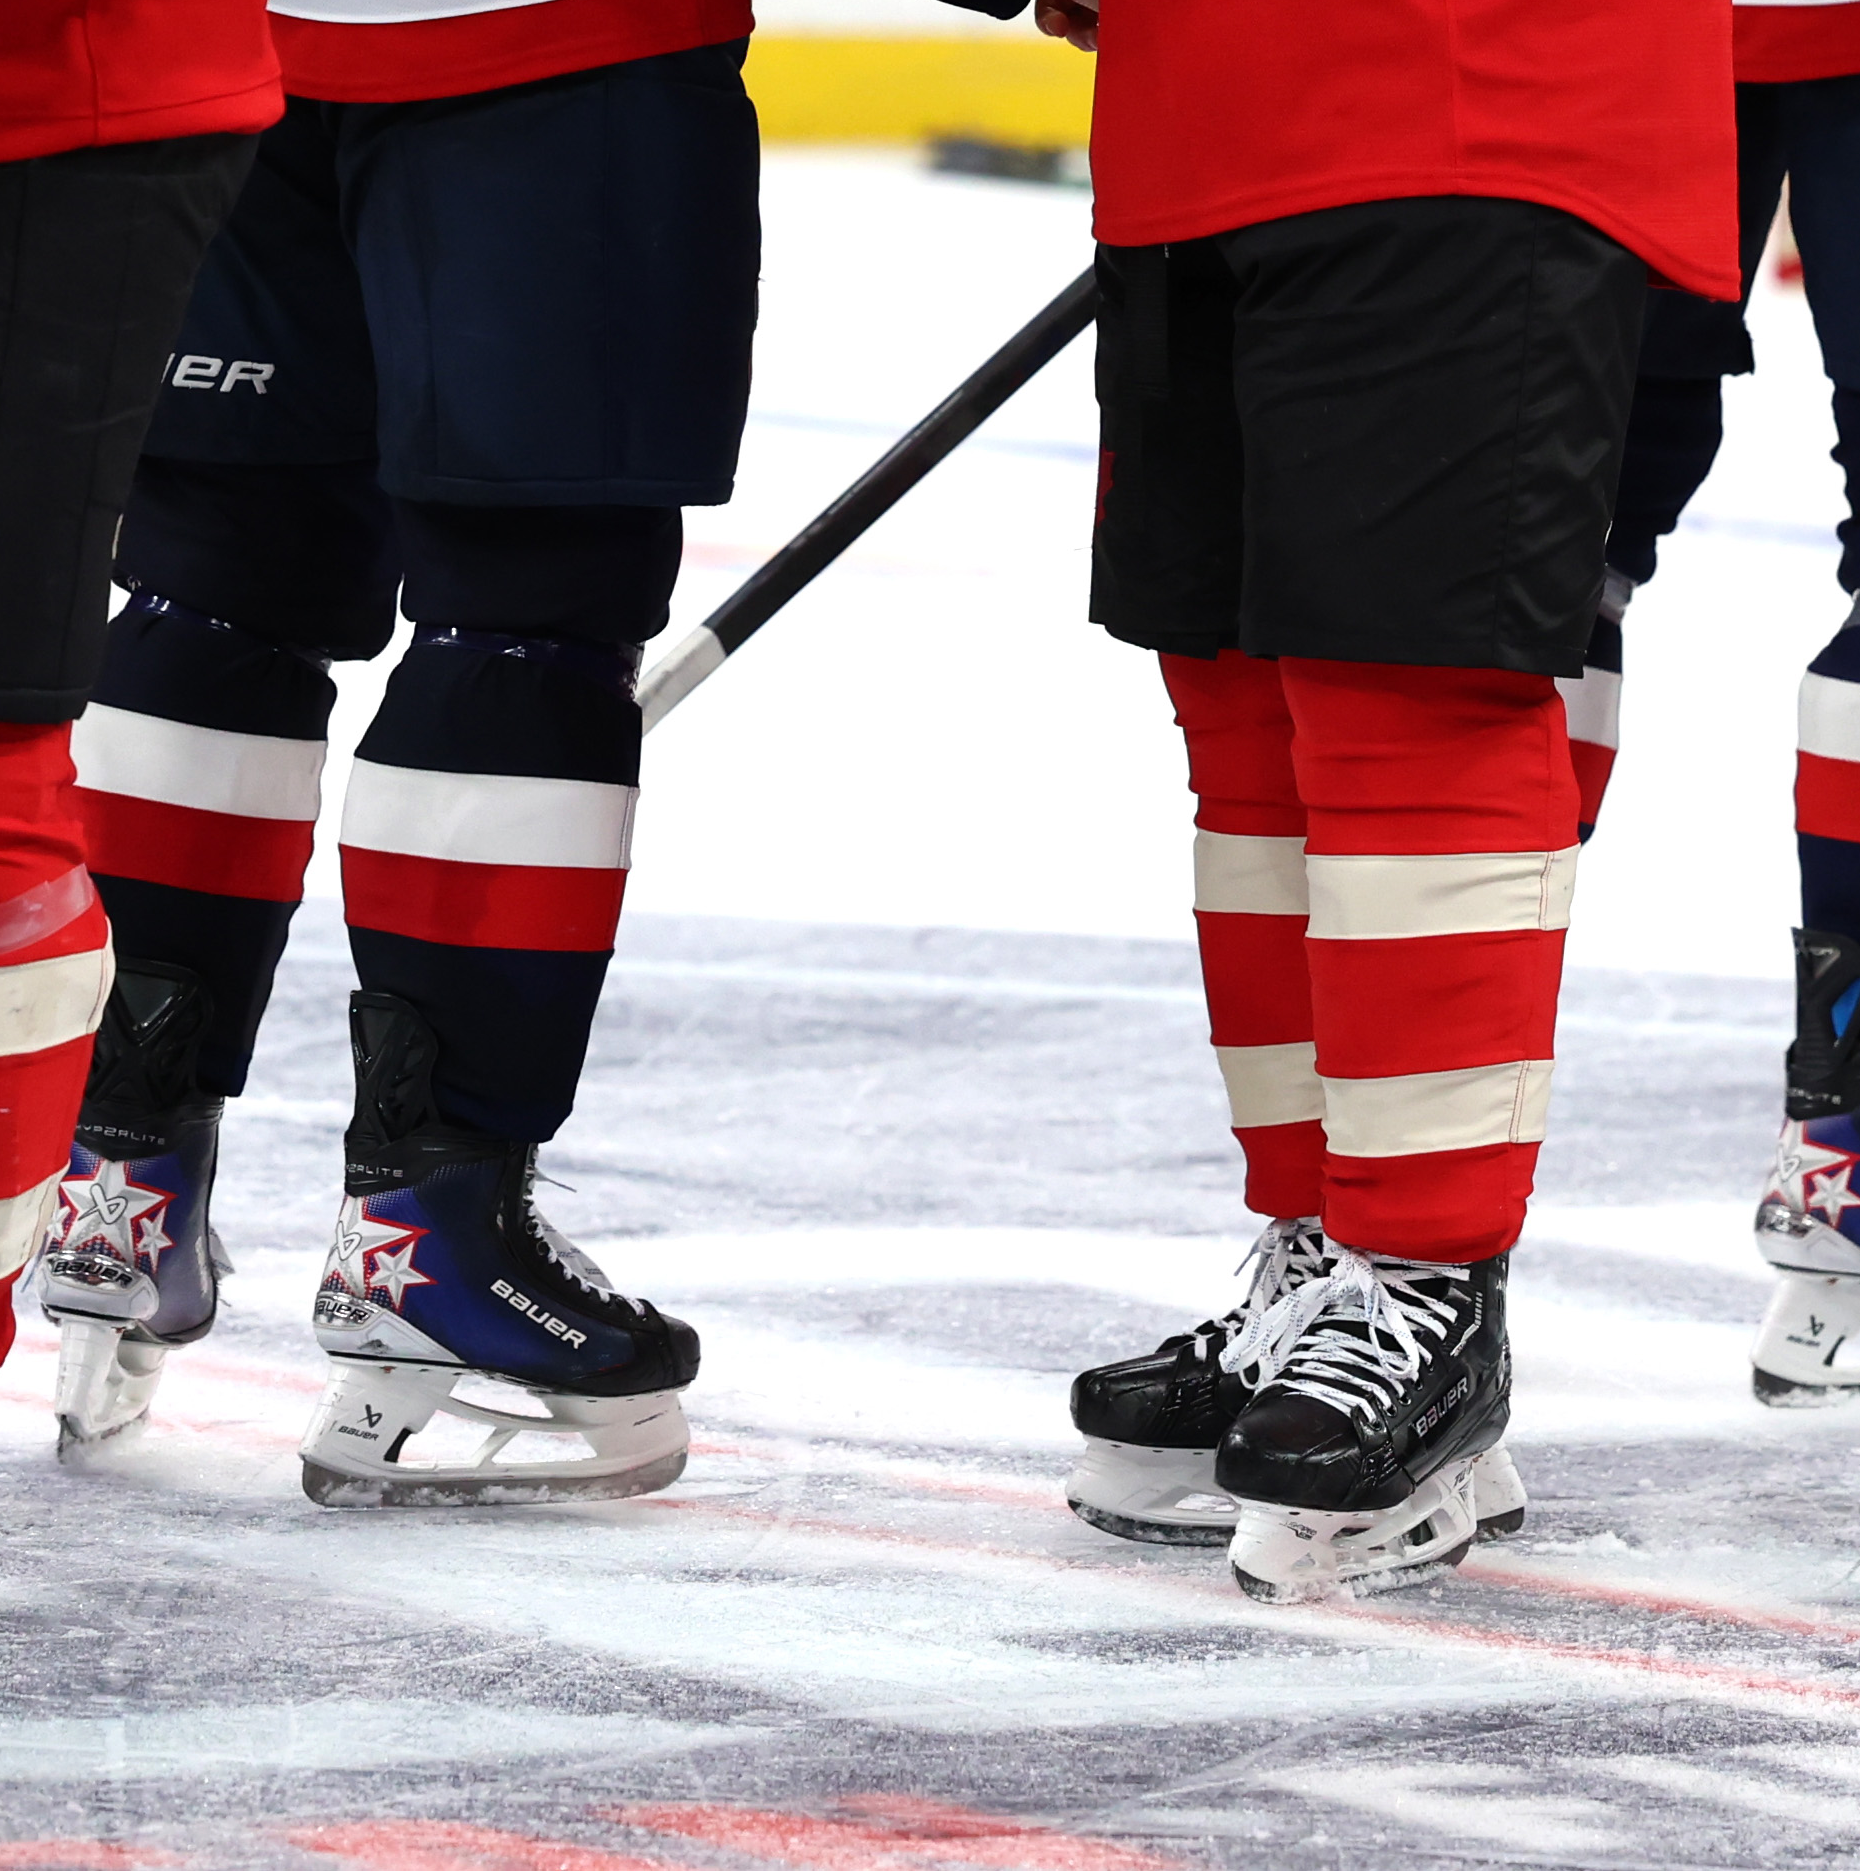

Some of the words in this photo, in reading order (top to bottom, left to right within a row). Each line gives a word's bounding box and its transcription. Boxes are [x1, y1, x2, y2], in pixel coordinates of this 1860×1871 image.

[52, 1260, 134, 1288] BAUER
[315, 1296, 370, 1324] AUER
[490, 1279, 588, 1350] BAUER
[1414, 1376, 1469, 1439] BAUER
[338, 1424, 380, 1442] BAUER
